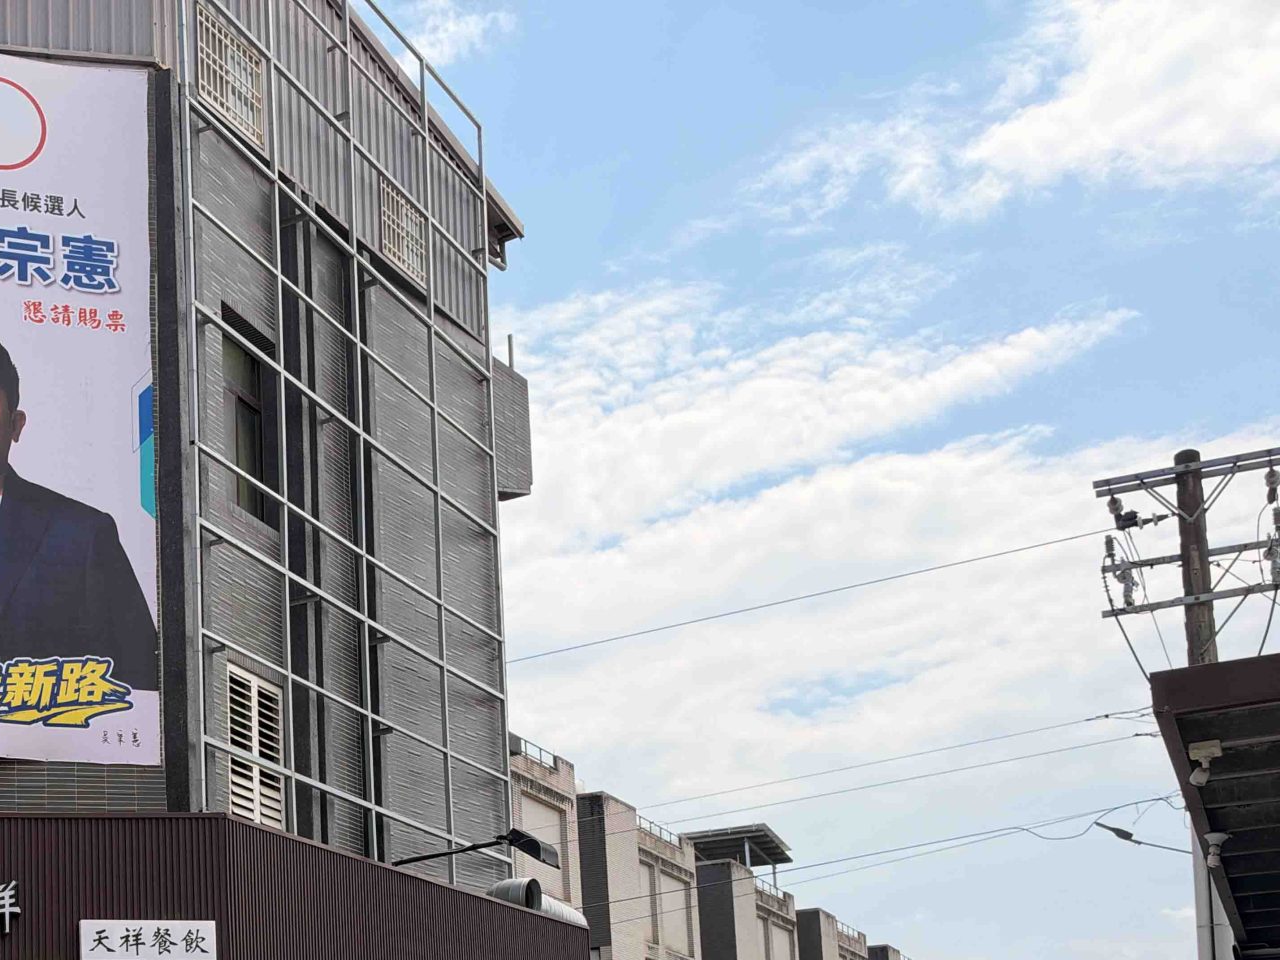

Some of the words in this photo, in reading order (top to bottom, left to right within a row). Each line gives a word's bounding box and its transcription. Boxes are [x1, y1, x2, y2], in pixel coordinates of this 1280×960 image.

[23, 300, 126, 333] 懇請賜票
[88, 926, 211, 956] 天祥餐飲
